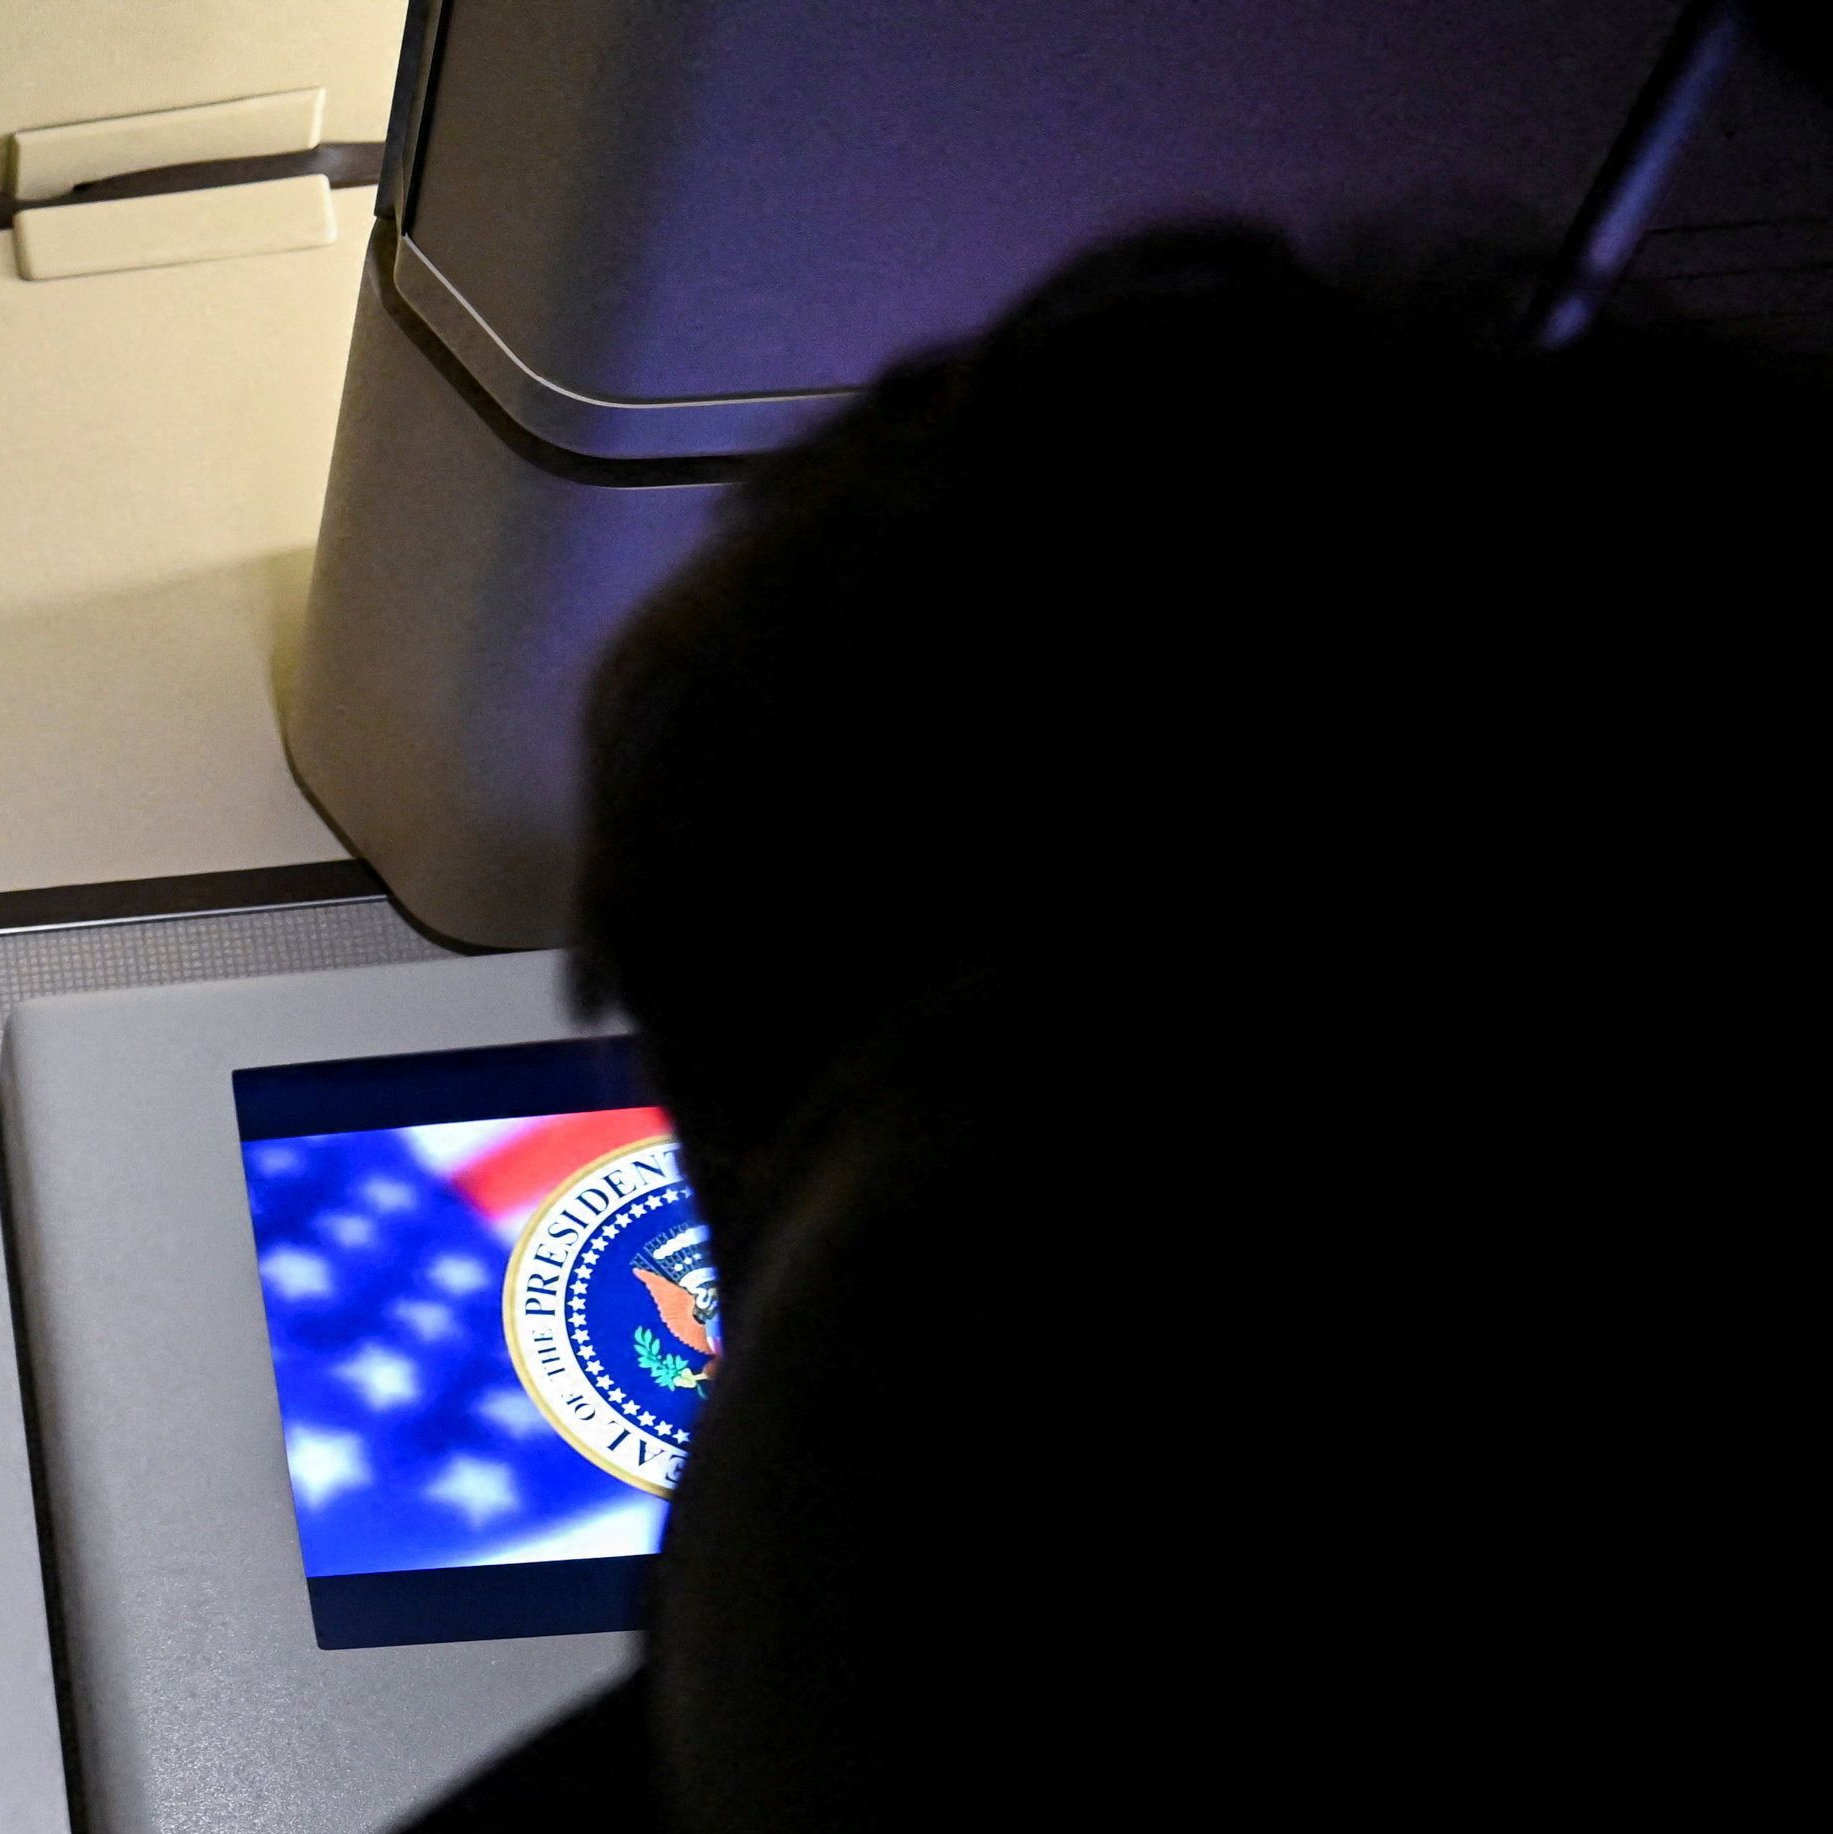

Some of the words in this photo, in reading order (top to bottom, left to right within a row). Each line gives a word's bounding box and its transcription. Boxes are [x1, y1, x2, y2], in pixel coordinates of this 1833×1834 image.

[531, 1328, 565, 1382] THE
[560, 1393, 596, 1421] OF
[605, 1418, 688, 1484] EAL
